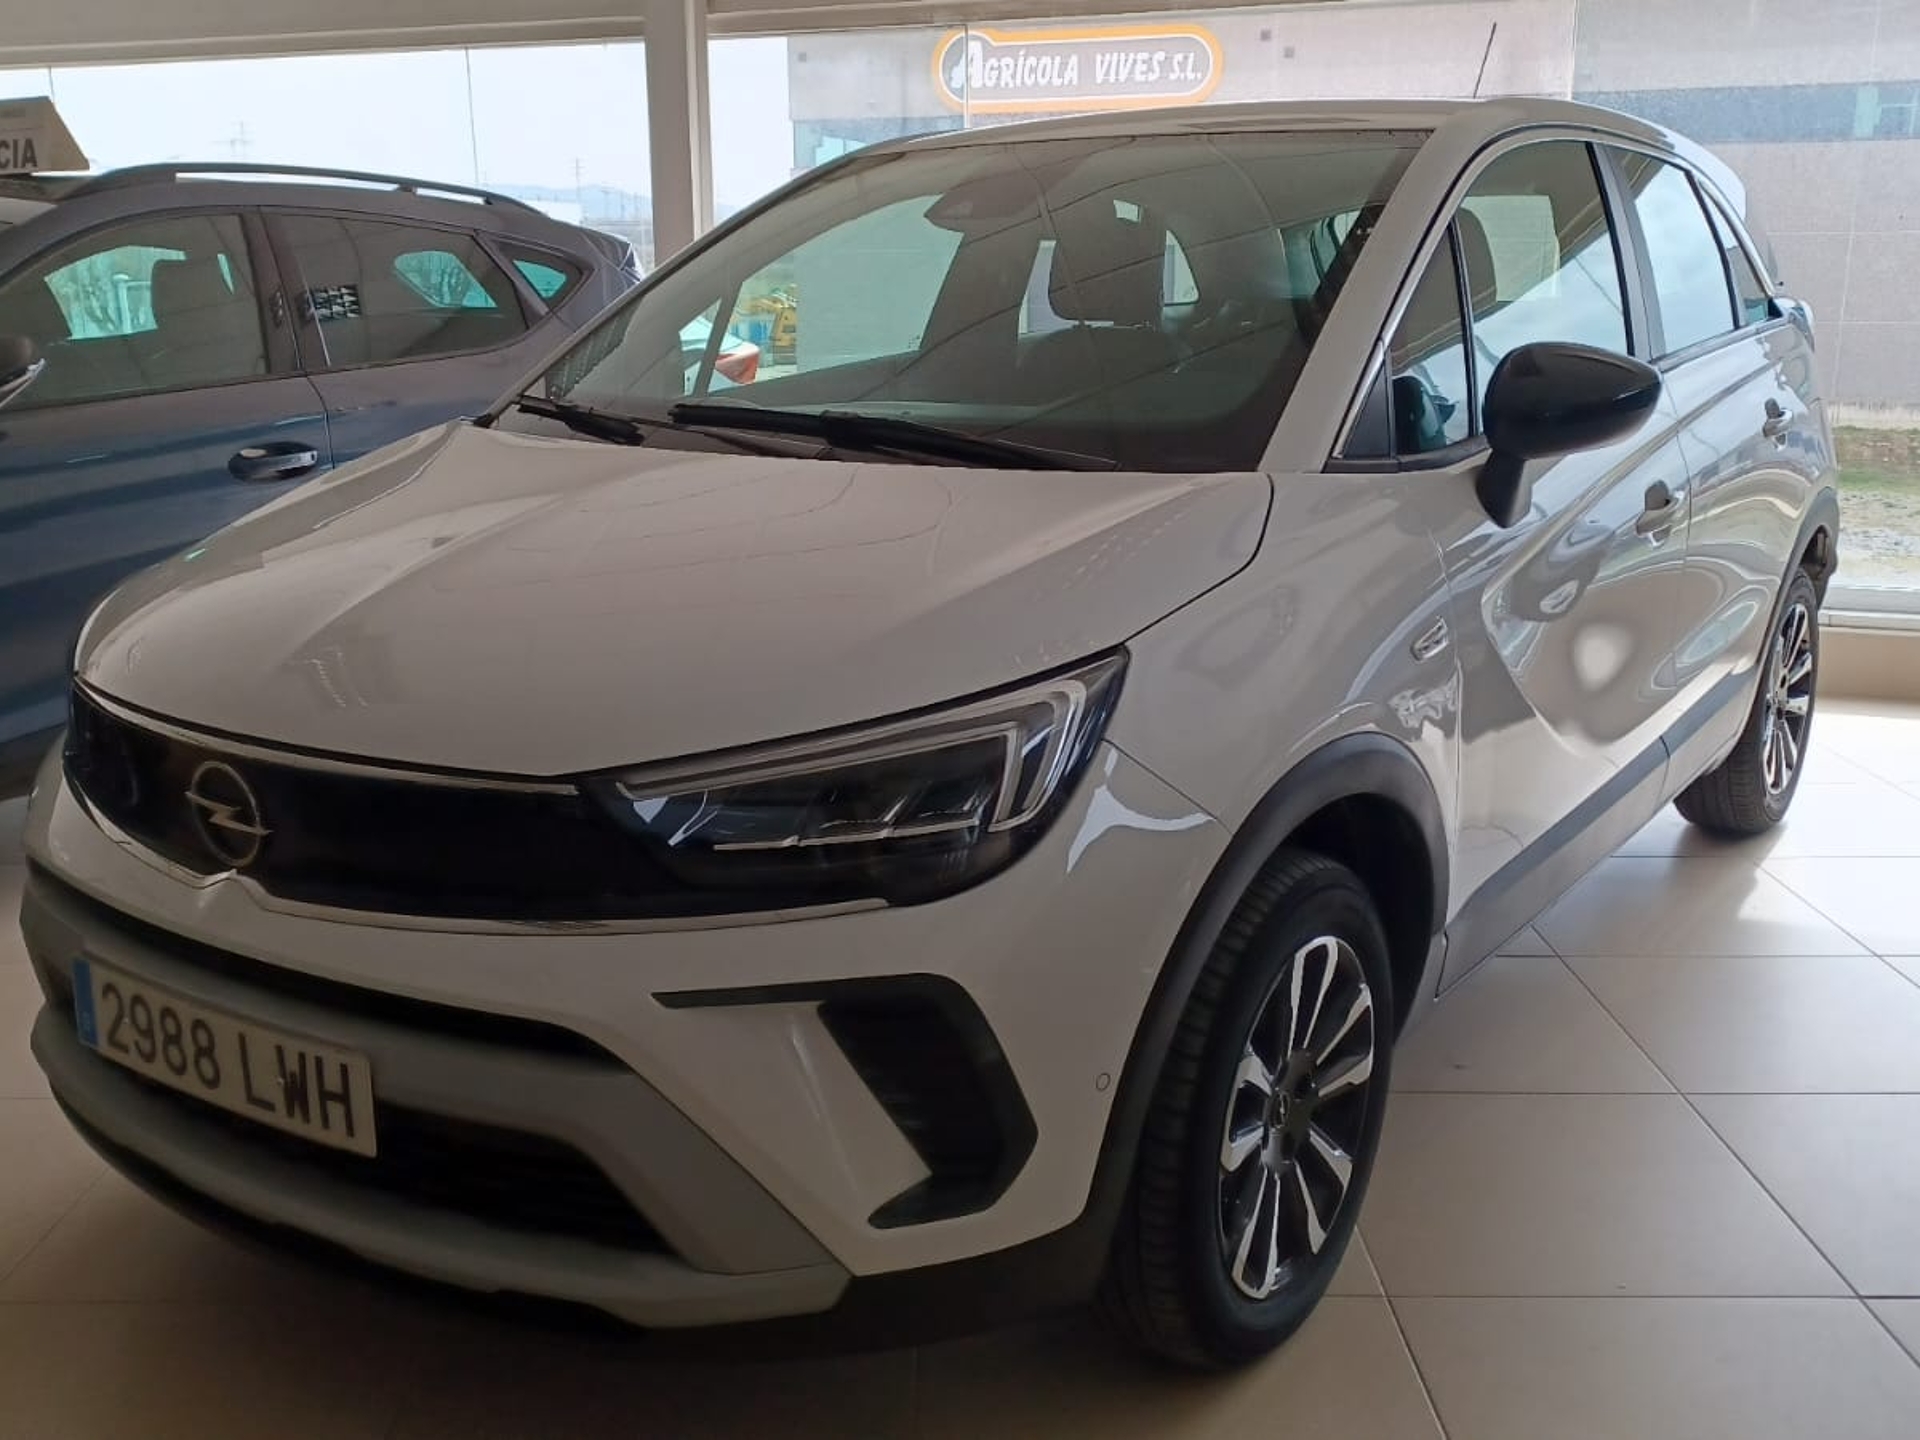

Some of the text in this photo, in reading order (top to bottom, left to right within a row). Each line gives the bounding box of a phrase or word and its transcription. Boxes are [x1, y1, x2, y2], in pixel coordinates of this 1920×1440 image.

[951, 40, 1079, 88] AGRÍCOLA
[1095, 50, 1166, 84] VIVES
[102, 982, 355, 1138] 2988 LWH
